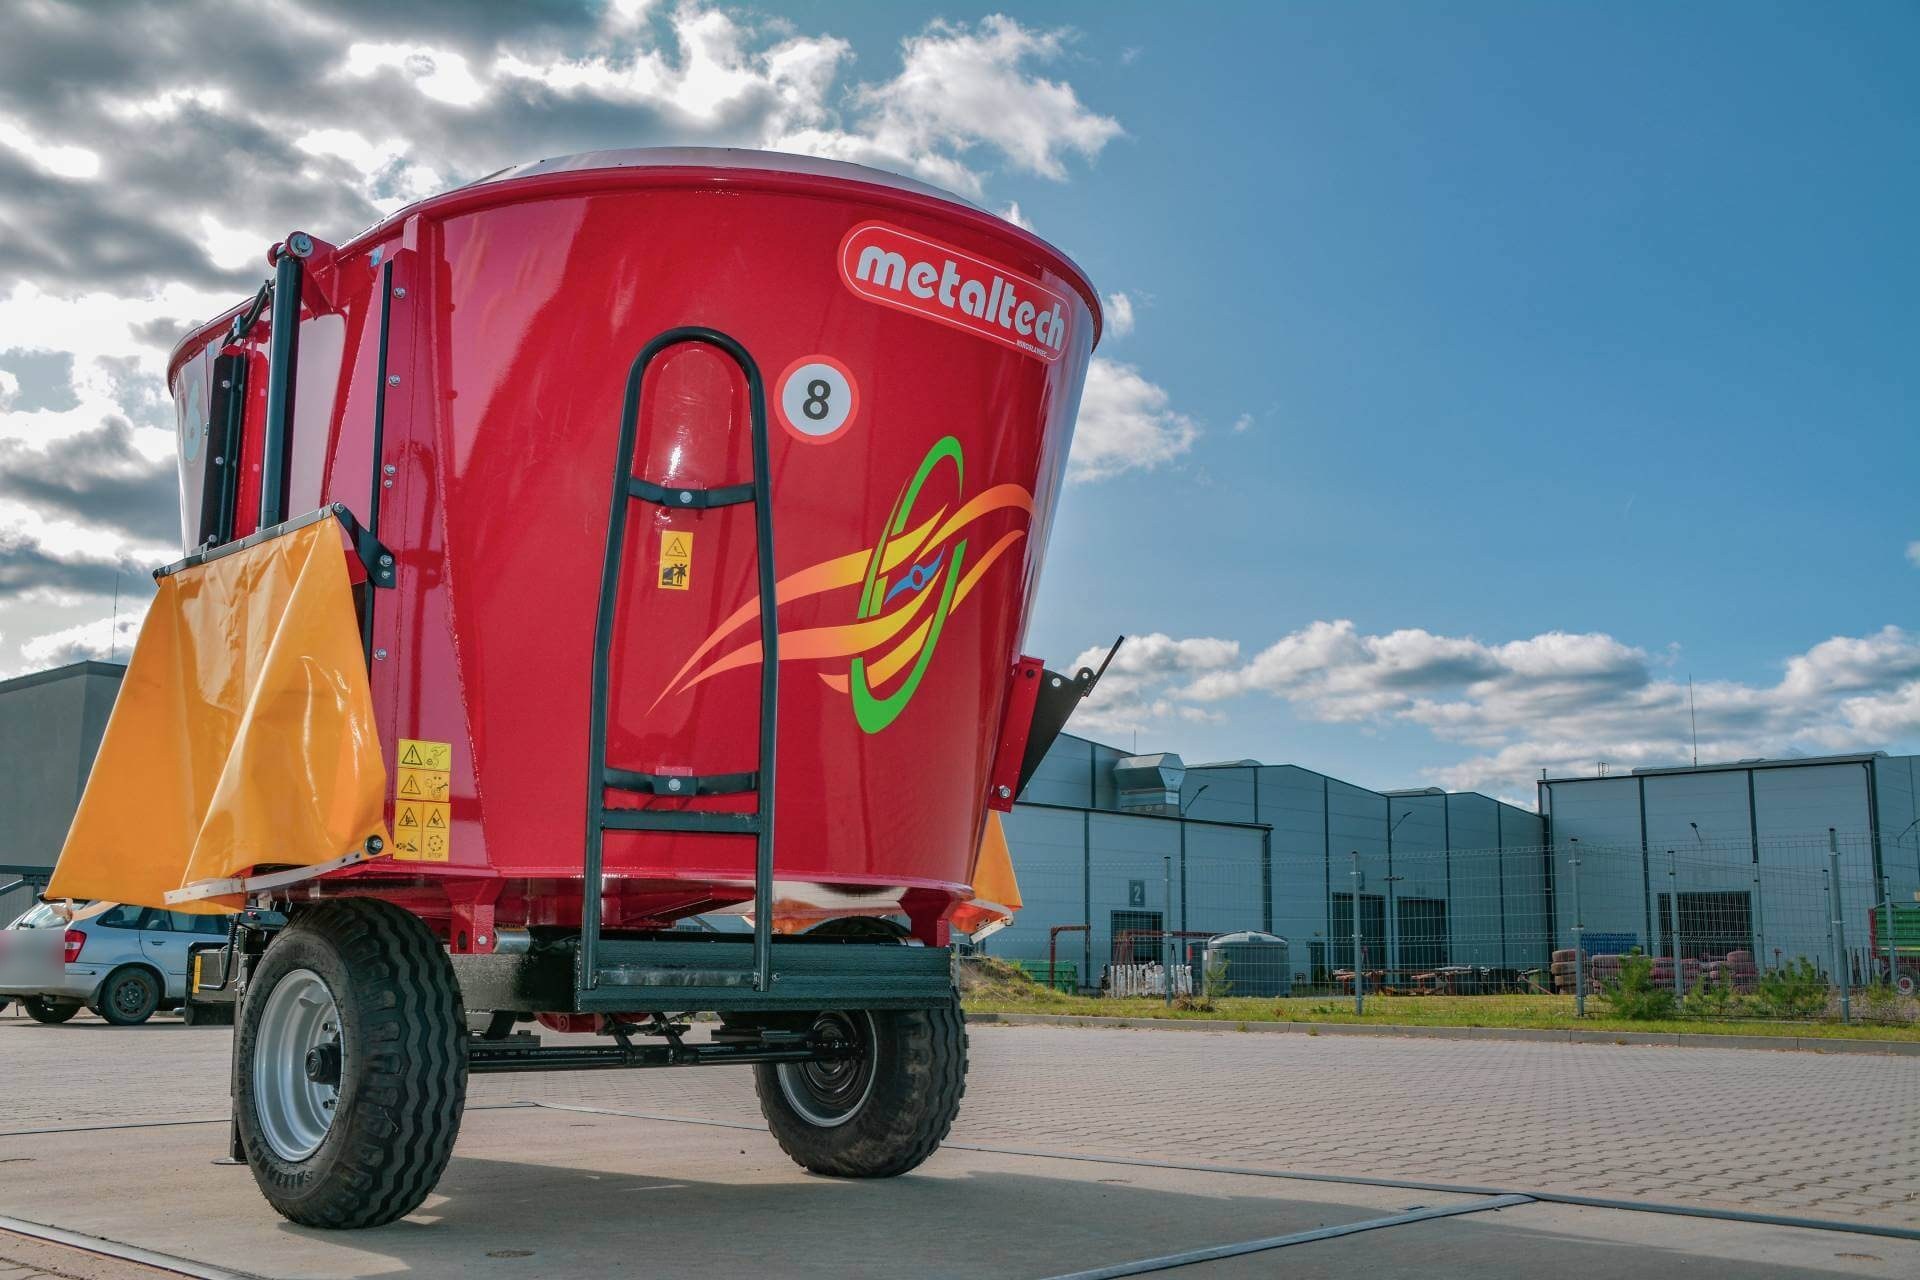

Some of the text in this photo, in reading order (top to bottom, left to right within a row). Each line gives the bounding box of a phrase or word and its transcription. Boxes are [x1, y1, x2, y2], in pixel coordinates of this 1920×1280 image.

[855, 245, 1065, 351] metaltech
[802, 379, 831, 420] 8
[1134, 885, 1141, 902] 2
